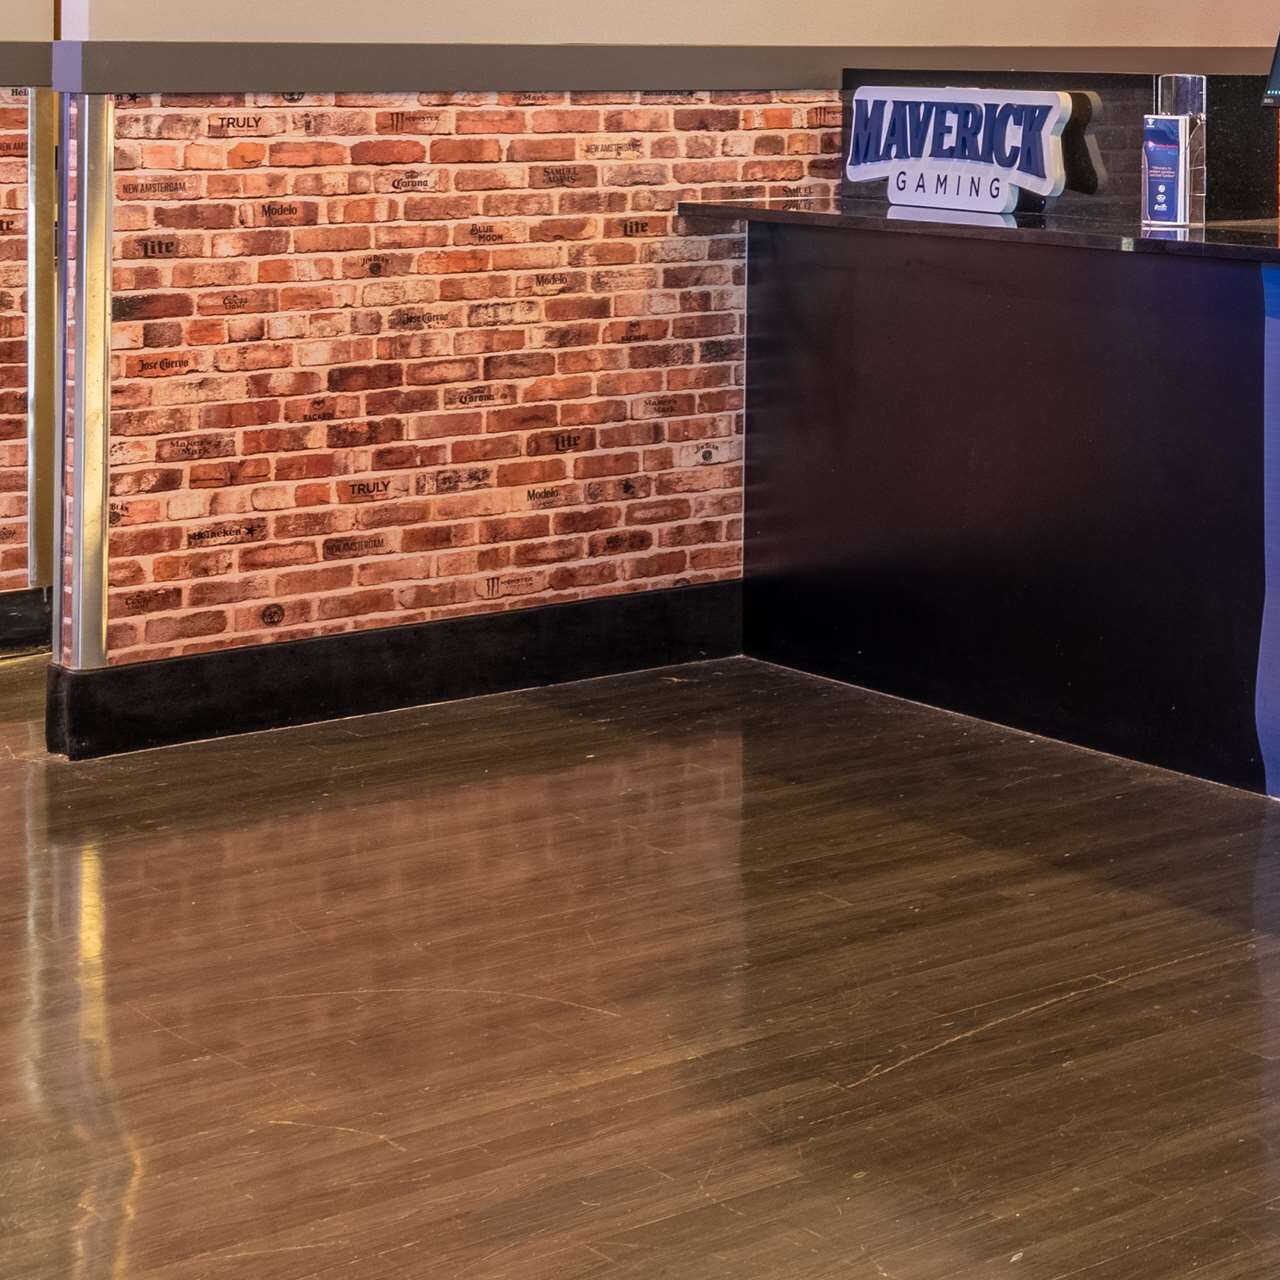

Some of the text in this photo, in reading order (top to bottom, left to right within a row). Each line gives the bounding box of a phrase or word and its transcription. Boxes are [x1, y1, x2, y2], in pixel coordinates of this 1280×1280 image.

[218, 117, 261, 129] TRULY
[849, 99, 1053, 178] MAVERICK
[123, 182, 185, 193] NEW AMSTERDAM
[392, 178, 428, 189] Corona
[896, 171, 1000, 199] GAMING
[262, 203, 298, 217] Modelo
[471, 223, 494, 234] BLUE
[624, 221, 648, 236] Lite
[140, 240, 174, 257] Lite
[139, 358, 188, 370] Jose Cuervo
[351, 481, 391, 495] TRULY
[193, 526, 242, 538] Heineken
